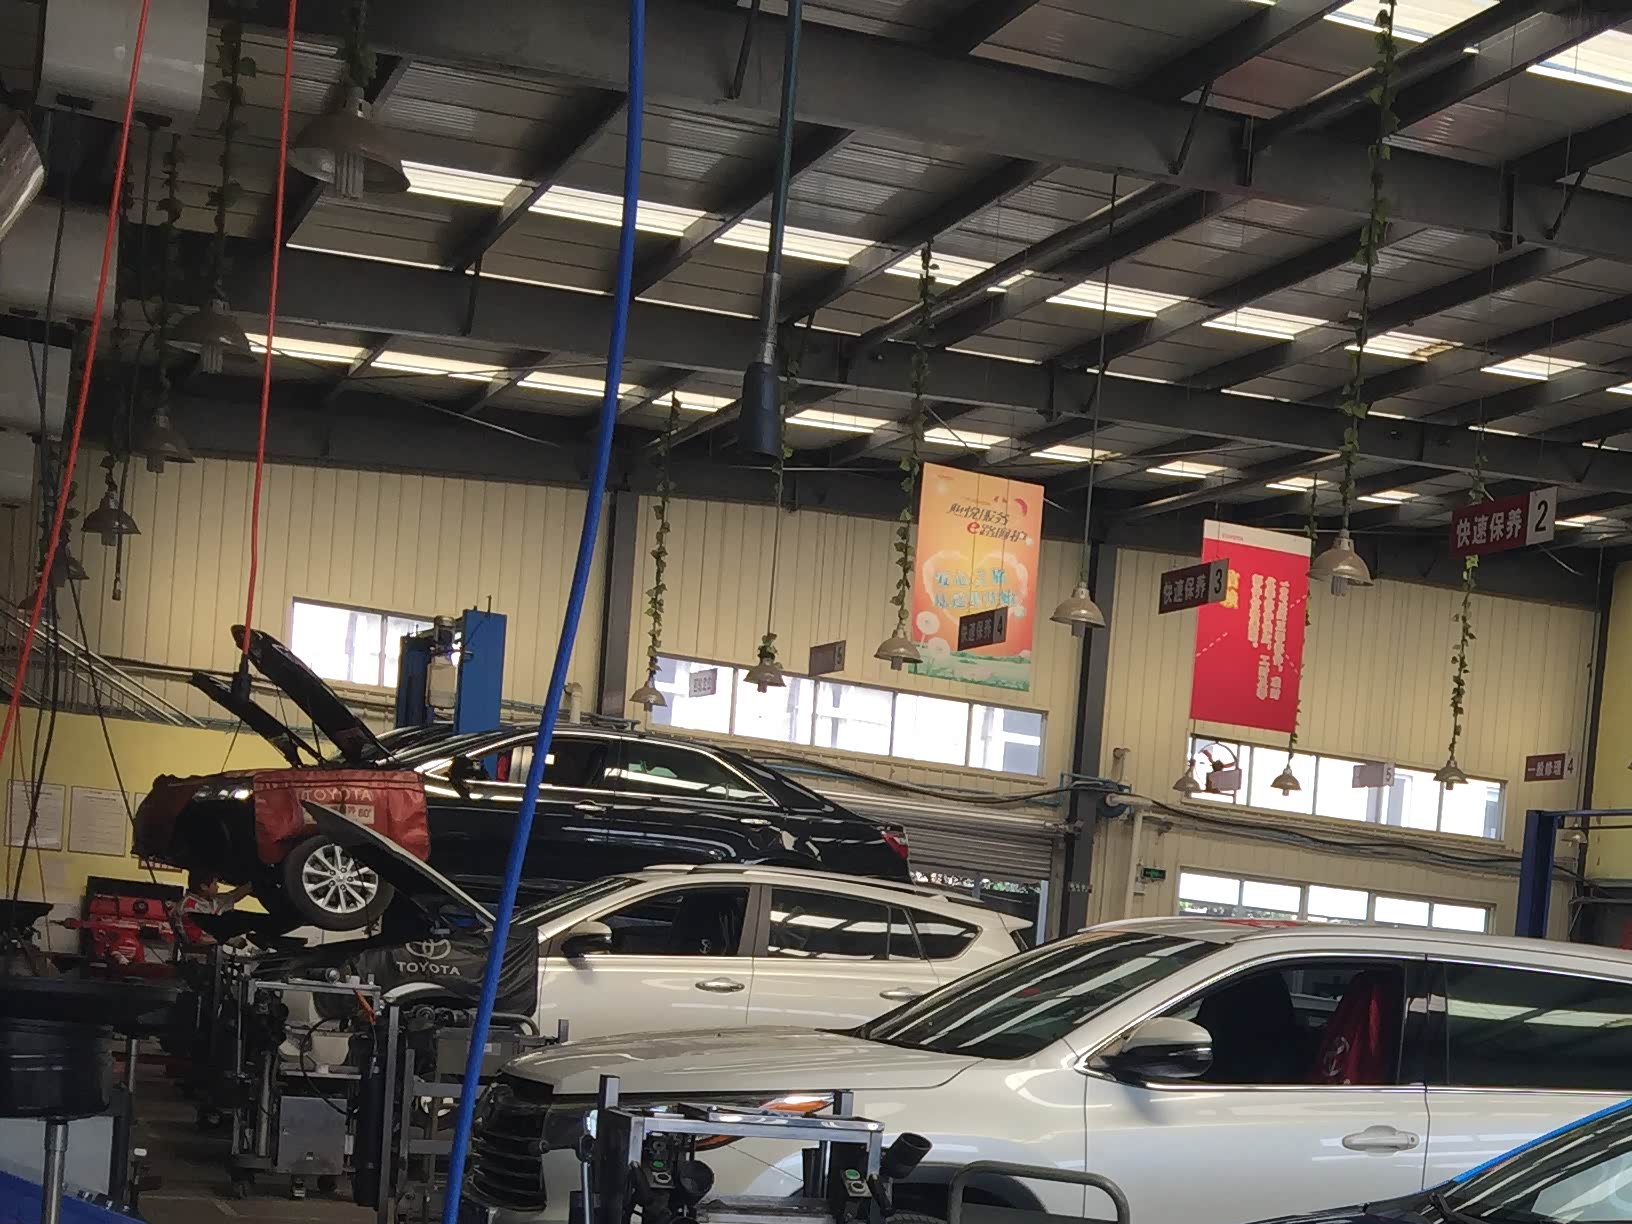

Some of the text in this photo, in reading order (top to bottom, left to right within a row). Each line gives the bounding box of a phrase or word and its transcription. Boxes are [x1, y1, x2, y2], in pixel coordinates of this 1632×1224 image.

[1456, 499, 1549, 549] 快速保养 2
[1163, 573, 1207, 606] 快速保养
[1214, 568, 1223, 594] 3
[1527, 757, 1574, 777] 一般修理 4
[396, 960, 460, 976] TOYOTA
